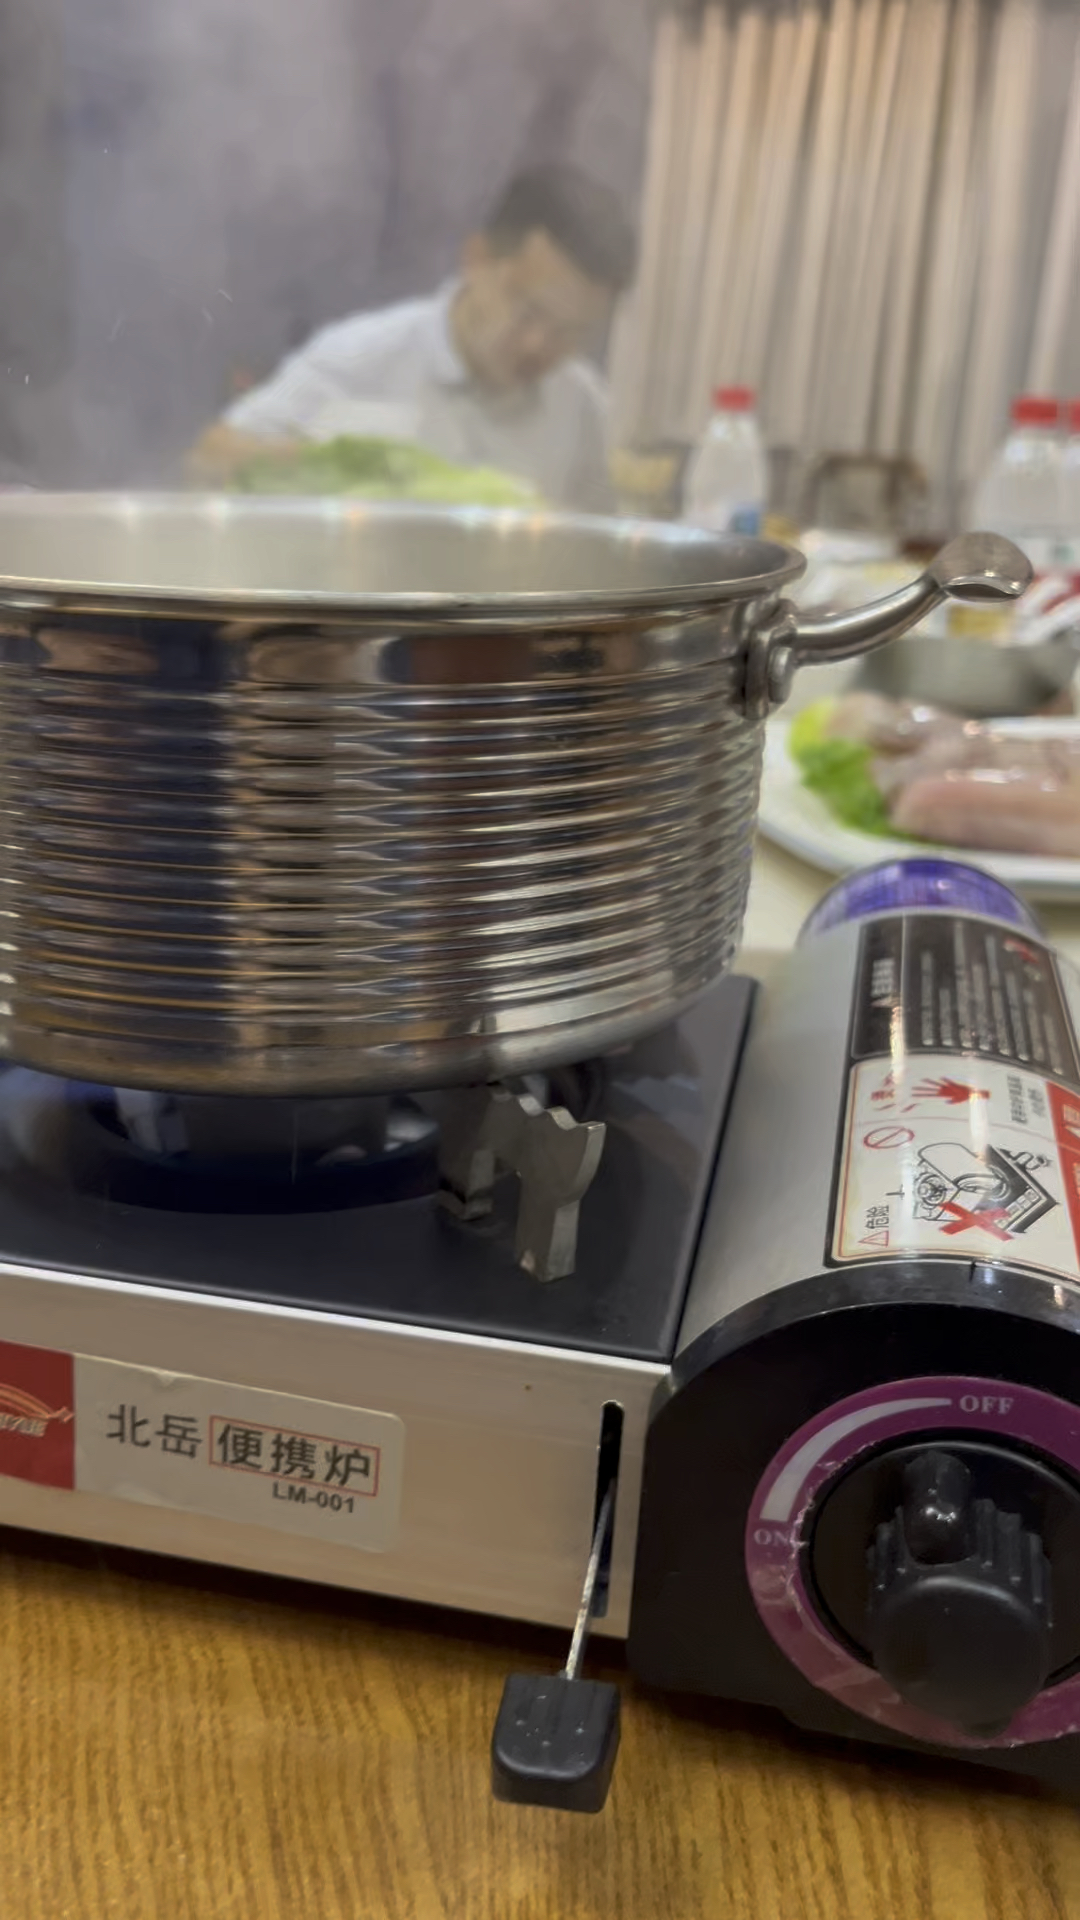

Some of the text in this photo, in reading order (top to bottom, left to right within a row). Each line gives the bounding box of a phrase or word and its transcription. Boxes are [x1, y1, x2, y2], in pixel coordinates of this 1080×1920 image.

[959, 1395, 1014, 1415] OFF
[106, 1404, 203, 1459] 北岳
[217, 1423, 371, 1487] 便携炉
[272, 1481, 355, 1514] LM-001
[753, 1528, 793, 1548] ON
